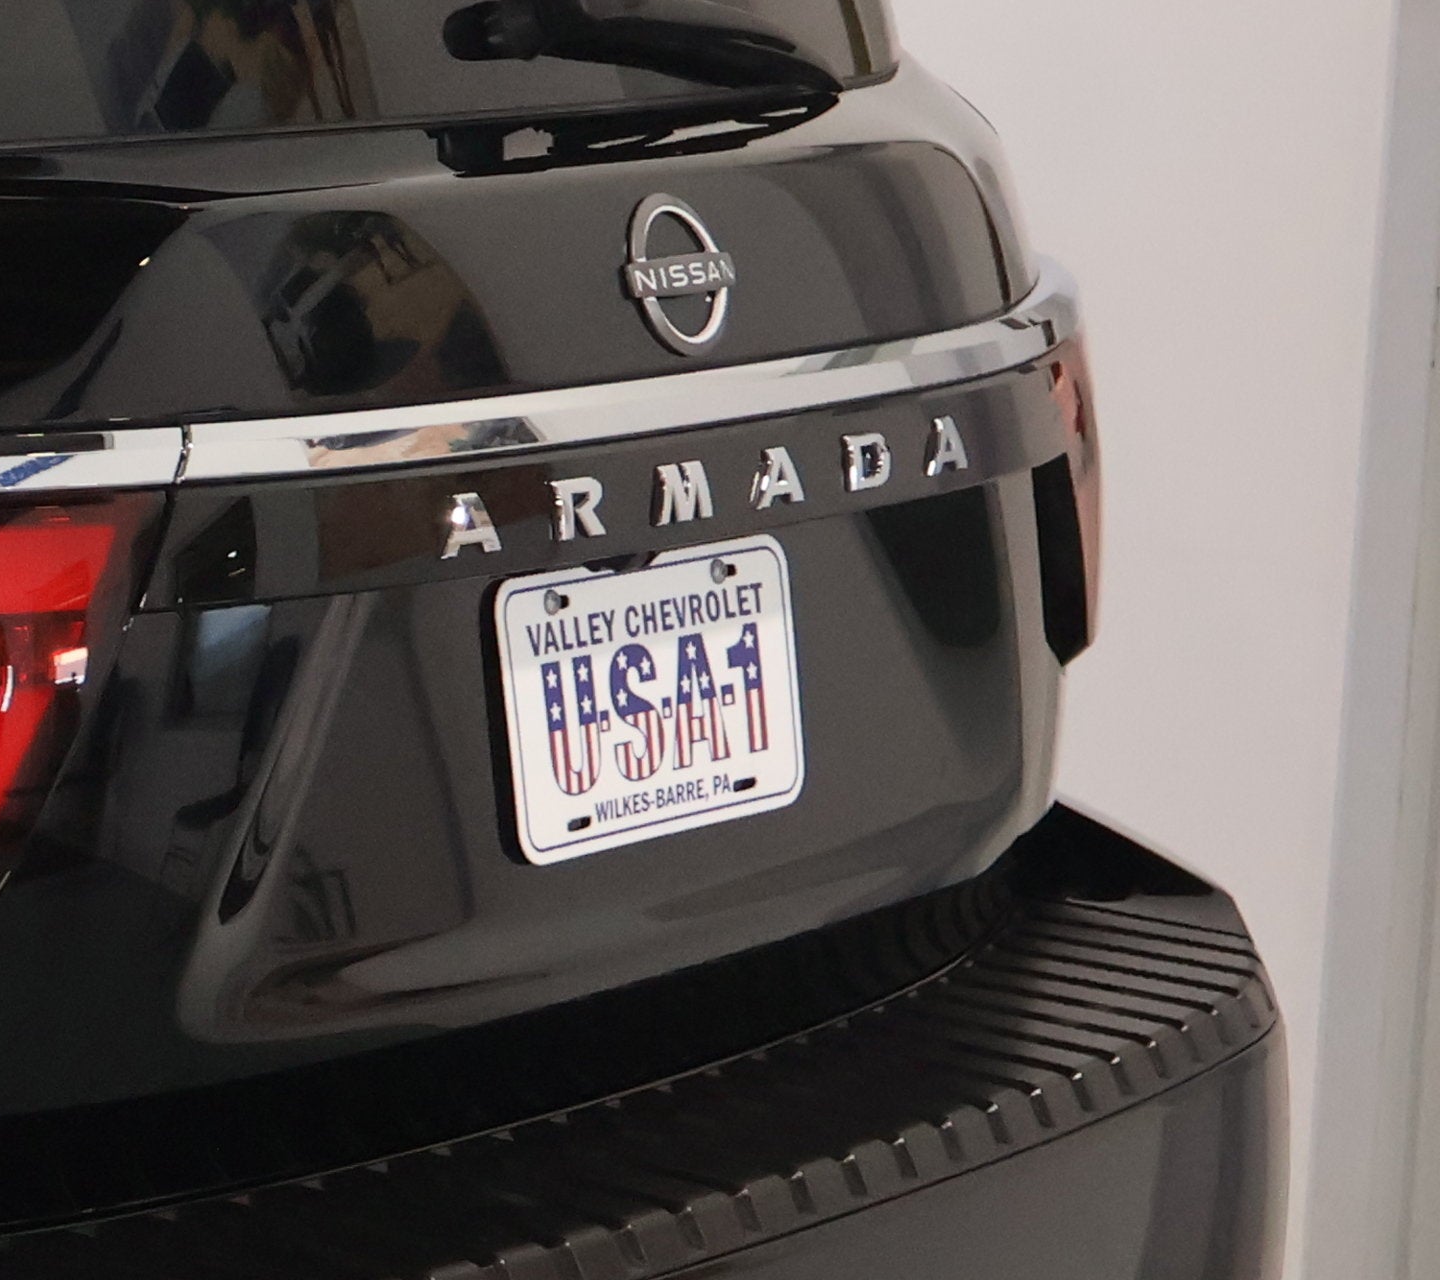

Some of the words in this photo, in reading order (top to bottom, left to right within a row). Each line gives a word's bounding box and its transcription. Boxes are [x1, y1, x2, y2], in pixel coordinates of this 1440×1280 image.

[633, 259, 735, 293] NISSAN
[441, 416, 970, 560] ARMADA
[526, 610, 616, 657] VALLEY
[625, 582, 763, 637] CHEVROLET
[595, 779, 710, 823] WILKES-BARRE,
[713, 773, 731, 795] PA
